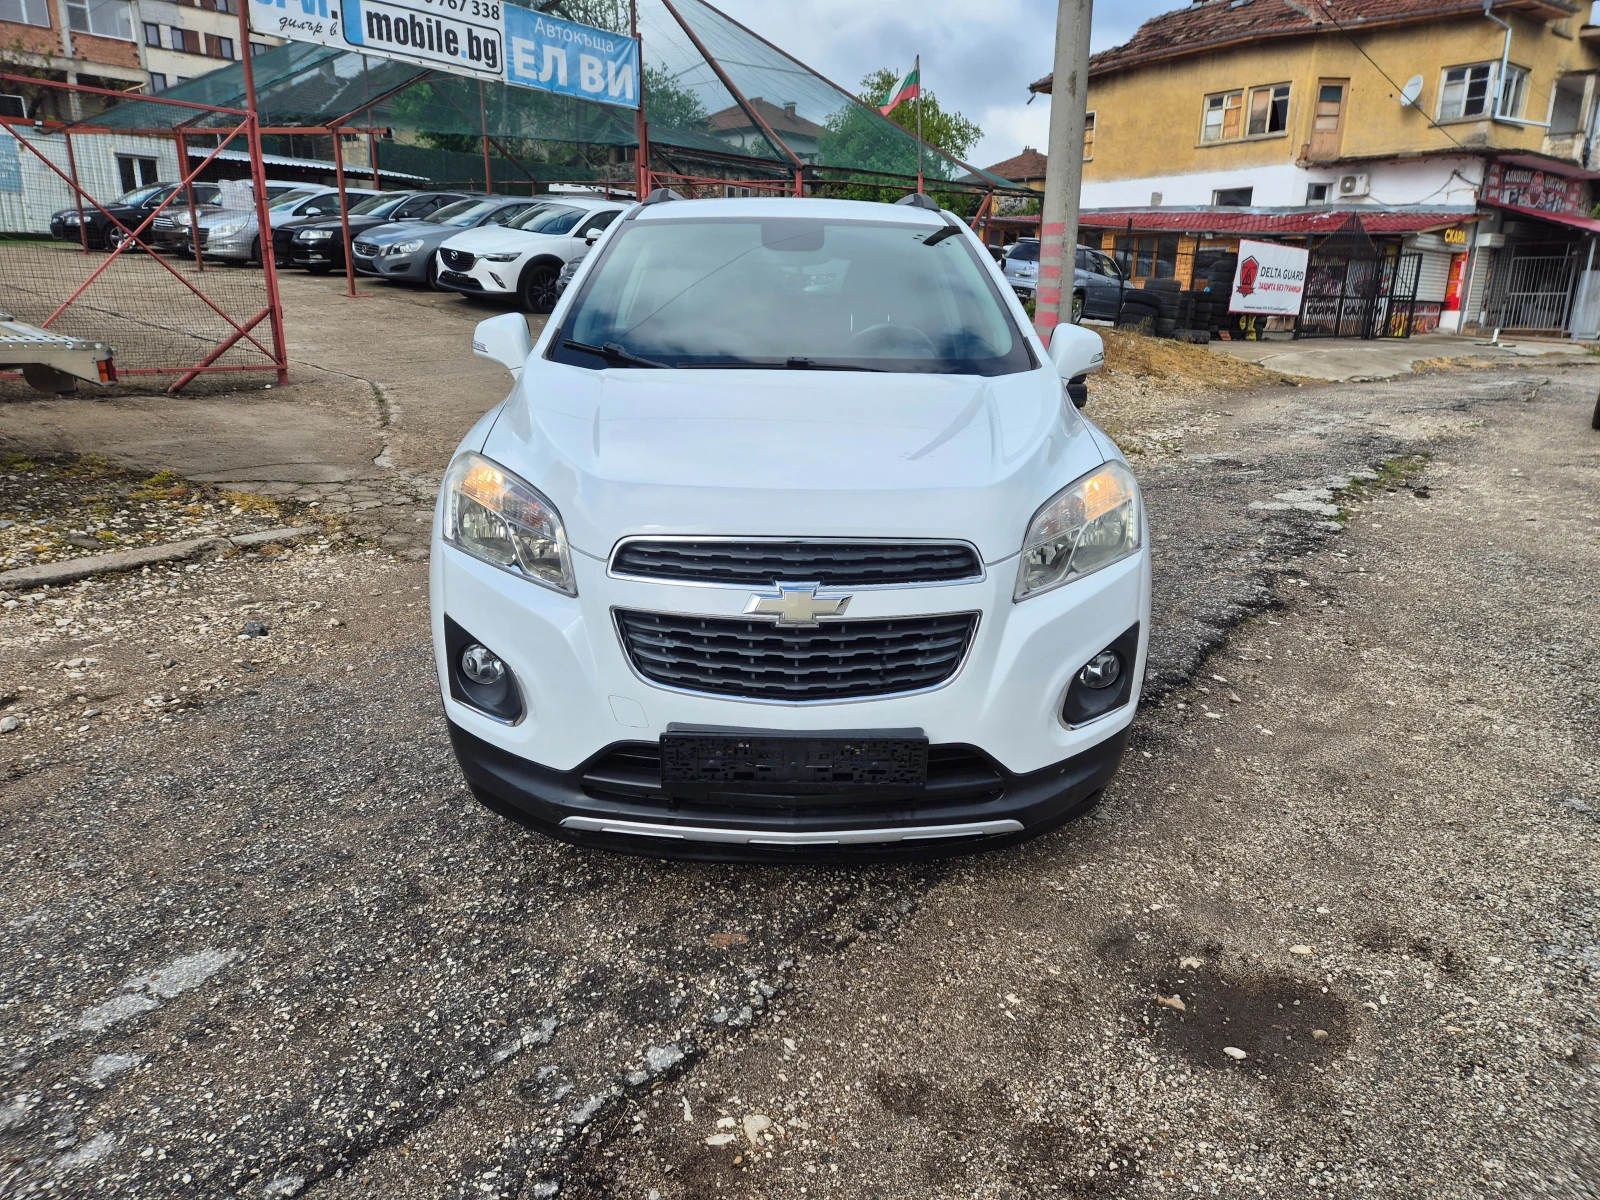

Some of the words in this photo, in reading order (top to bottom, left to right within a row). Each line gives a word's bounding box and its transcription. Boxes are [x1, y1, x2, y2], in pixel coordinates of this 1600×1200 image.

[472, 0, 500, 20] 338
[366, 11, 498, 69] mobile.bg
[534, 17, 615, 53] Автокъща
[511, 36, 568, 87] ЕЛ
[580, 53, 634, 100] ВИ
[1444, 228, 1466, 244] СКАРА
[1260, 266, 1282, 279] DELTA
[1282, 269, 1304, 281] GUARD
